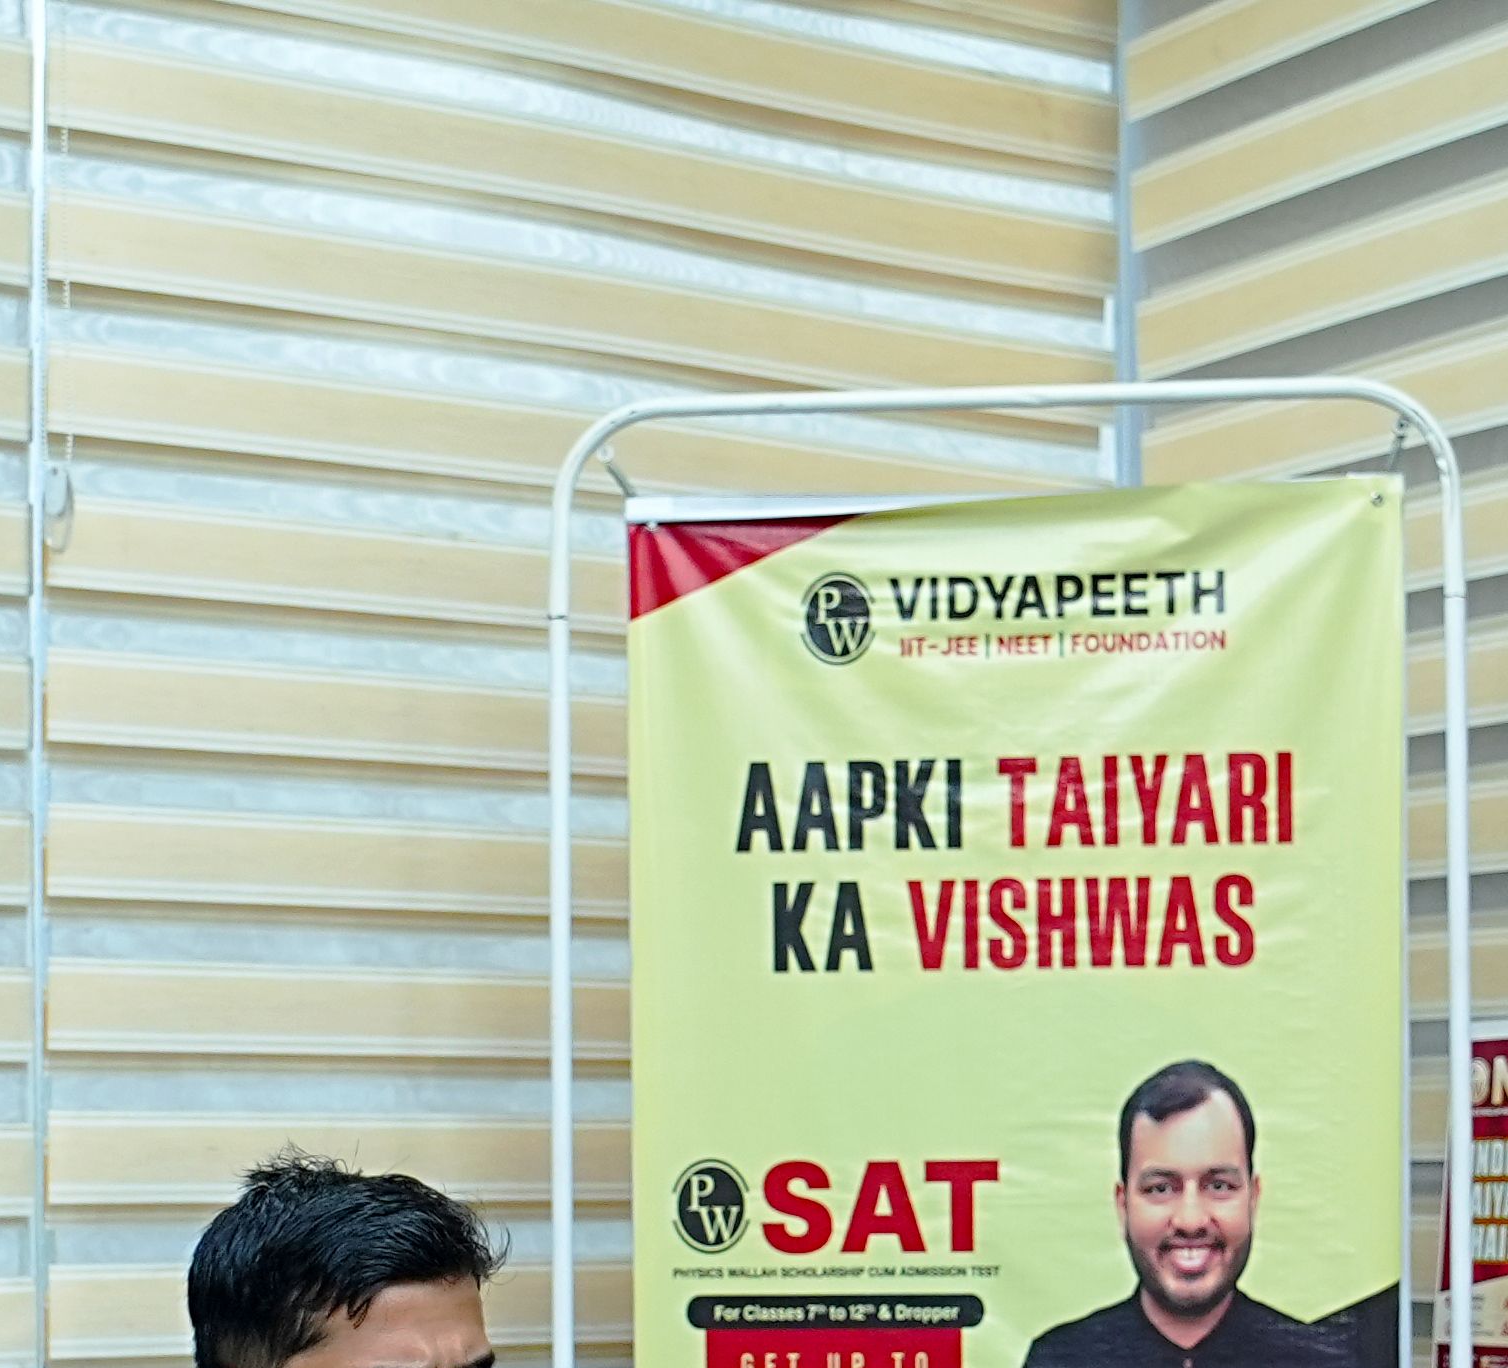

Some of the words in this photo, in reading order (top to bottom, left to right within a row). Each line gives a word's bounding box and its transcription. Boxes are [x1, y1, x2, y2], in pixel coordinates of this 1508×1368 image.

[890, 570, 1226, 621] VIDYAPEETH
[899, 633, 979, 658] IIT-JEE
[997, 632, 1053, 656] NEET
[1071, 629, 1227, 655] FOUNDATION
[736, 759, 963, 854] AAPKI
[997, 750, 1294, 849] TAIYARI
[773, 881, 874, 974] KA
[907, 873, 1256, 972] VISHWAS
[762, 1159, 1000, 1254] SAT
[713, 1304, 741, 1322] For
[742, 1304, 805, 1323] Classes
[828, 1304, 848, 1322] to
[877, 1304, 892, 1322] &
[894, 1303, 961, 1325] Dropper
